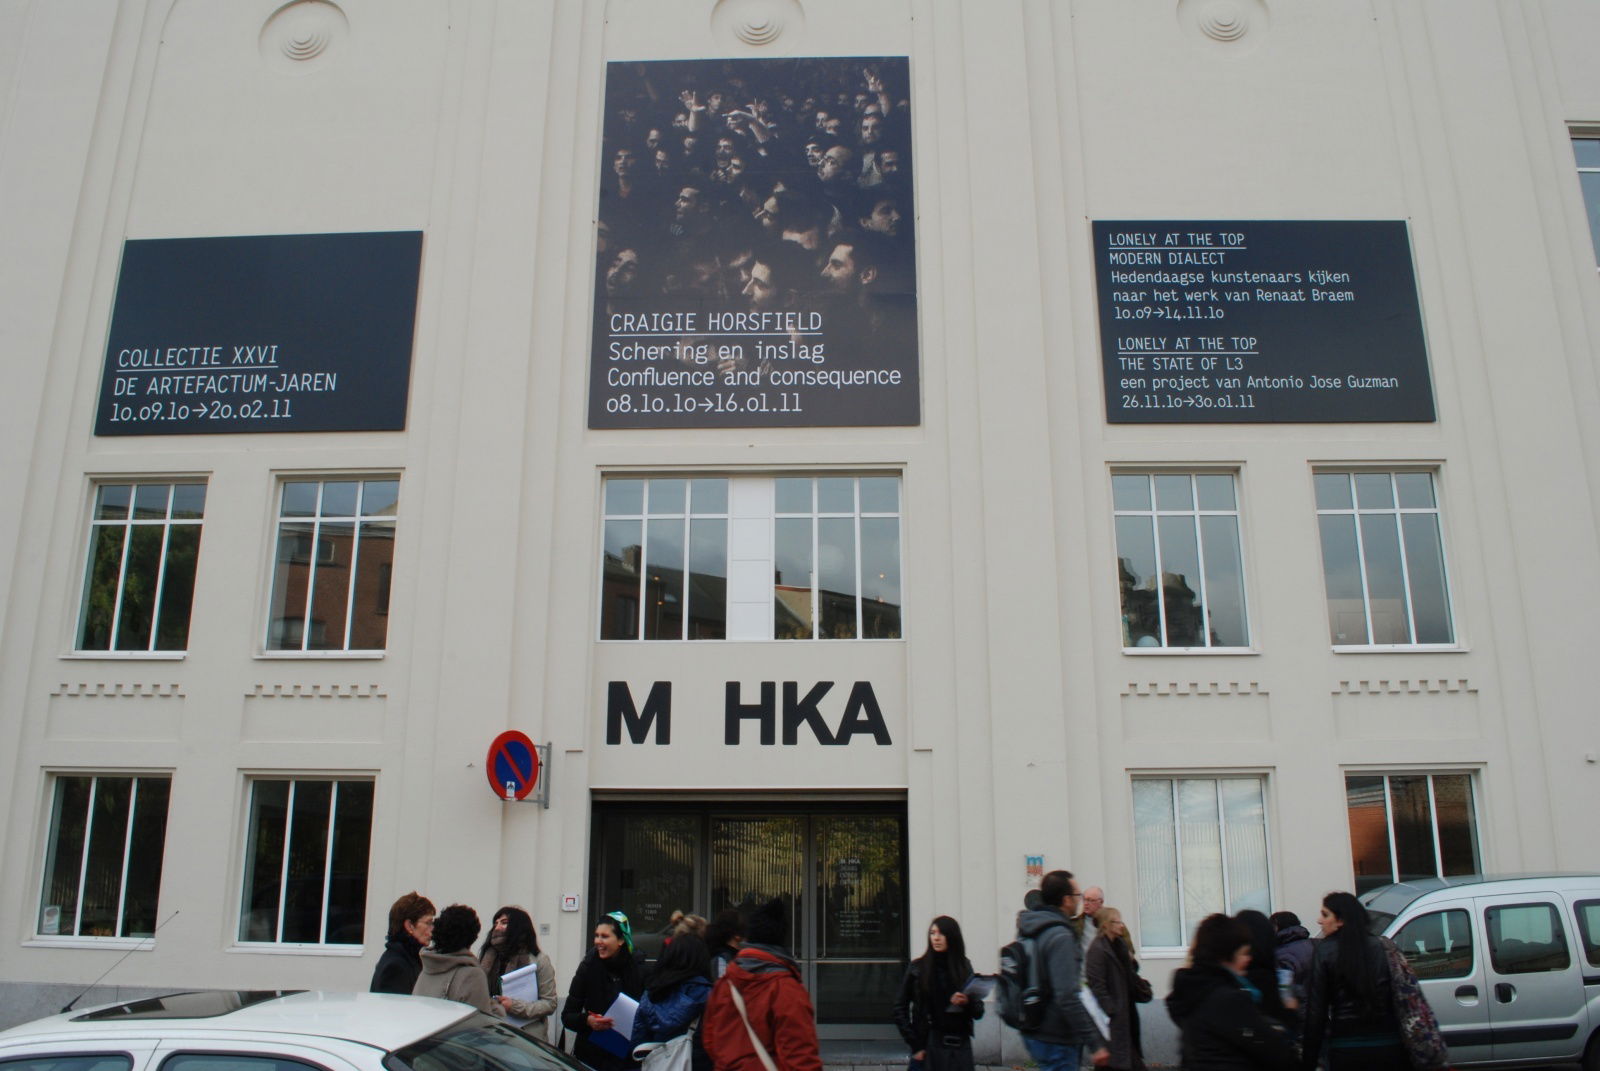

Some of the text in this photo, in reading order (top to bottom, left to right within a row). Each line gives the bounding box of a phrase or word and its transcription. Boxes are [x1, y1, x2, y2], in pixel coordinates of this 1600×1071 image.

[1109, 233, 1244, 246] LONELY AT THE TOP
[1110, 253, 1225, 265] MODERN DIALECT
[1112, 271, 1350, 286] Hedendaagse kunstenaars kijken
[1113, 289, 1354, 301] naar het werk van Renaat Braem
[610, 313, 822, 333] CRAIGIE HORSFIELD
[1118, 337, 1257, 350] LONELY AT THE TOP
[118, 346, 278, 367] COLLECTIE XXVI
[609, 341, 824, 364] Schering en inslag
[1119, 358, 1243, 371] THE STATE OF L3
[114, 373, 337, 396] DE ARTEFACTUM-JAREN
[608, 367, 900, 389] Confluence and consequence
[1120, 375, 1398, 391] een project van Antonio Jose Guzman
[606, 681, 892, 745] M HKA
